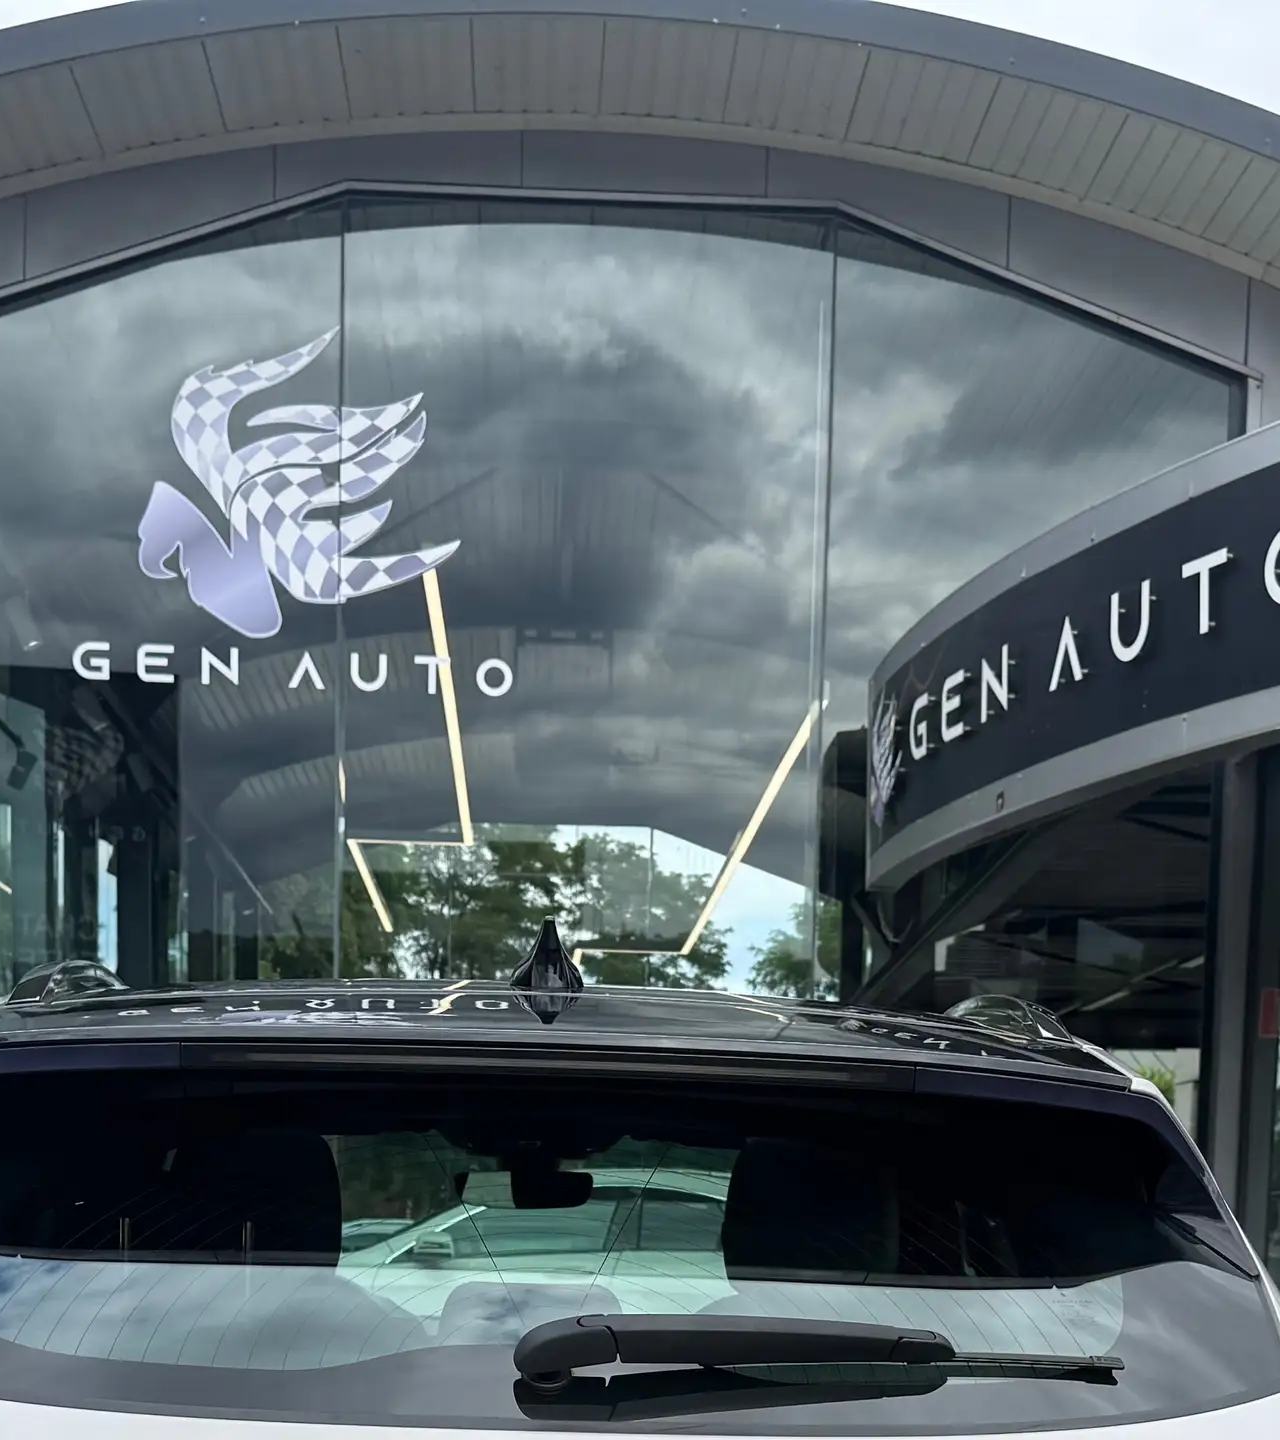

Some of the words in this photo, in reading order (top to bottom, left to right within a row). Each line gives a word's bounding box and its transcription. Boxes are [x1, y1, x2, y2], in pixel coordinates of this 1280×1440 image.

[72, 641, 240, 686] GEN
[288, 651, 513, 698] AUTO
[908, 643, 1010, 761] GEN
